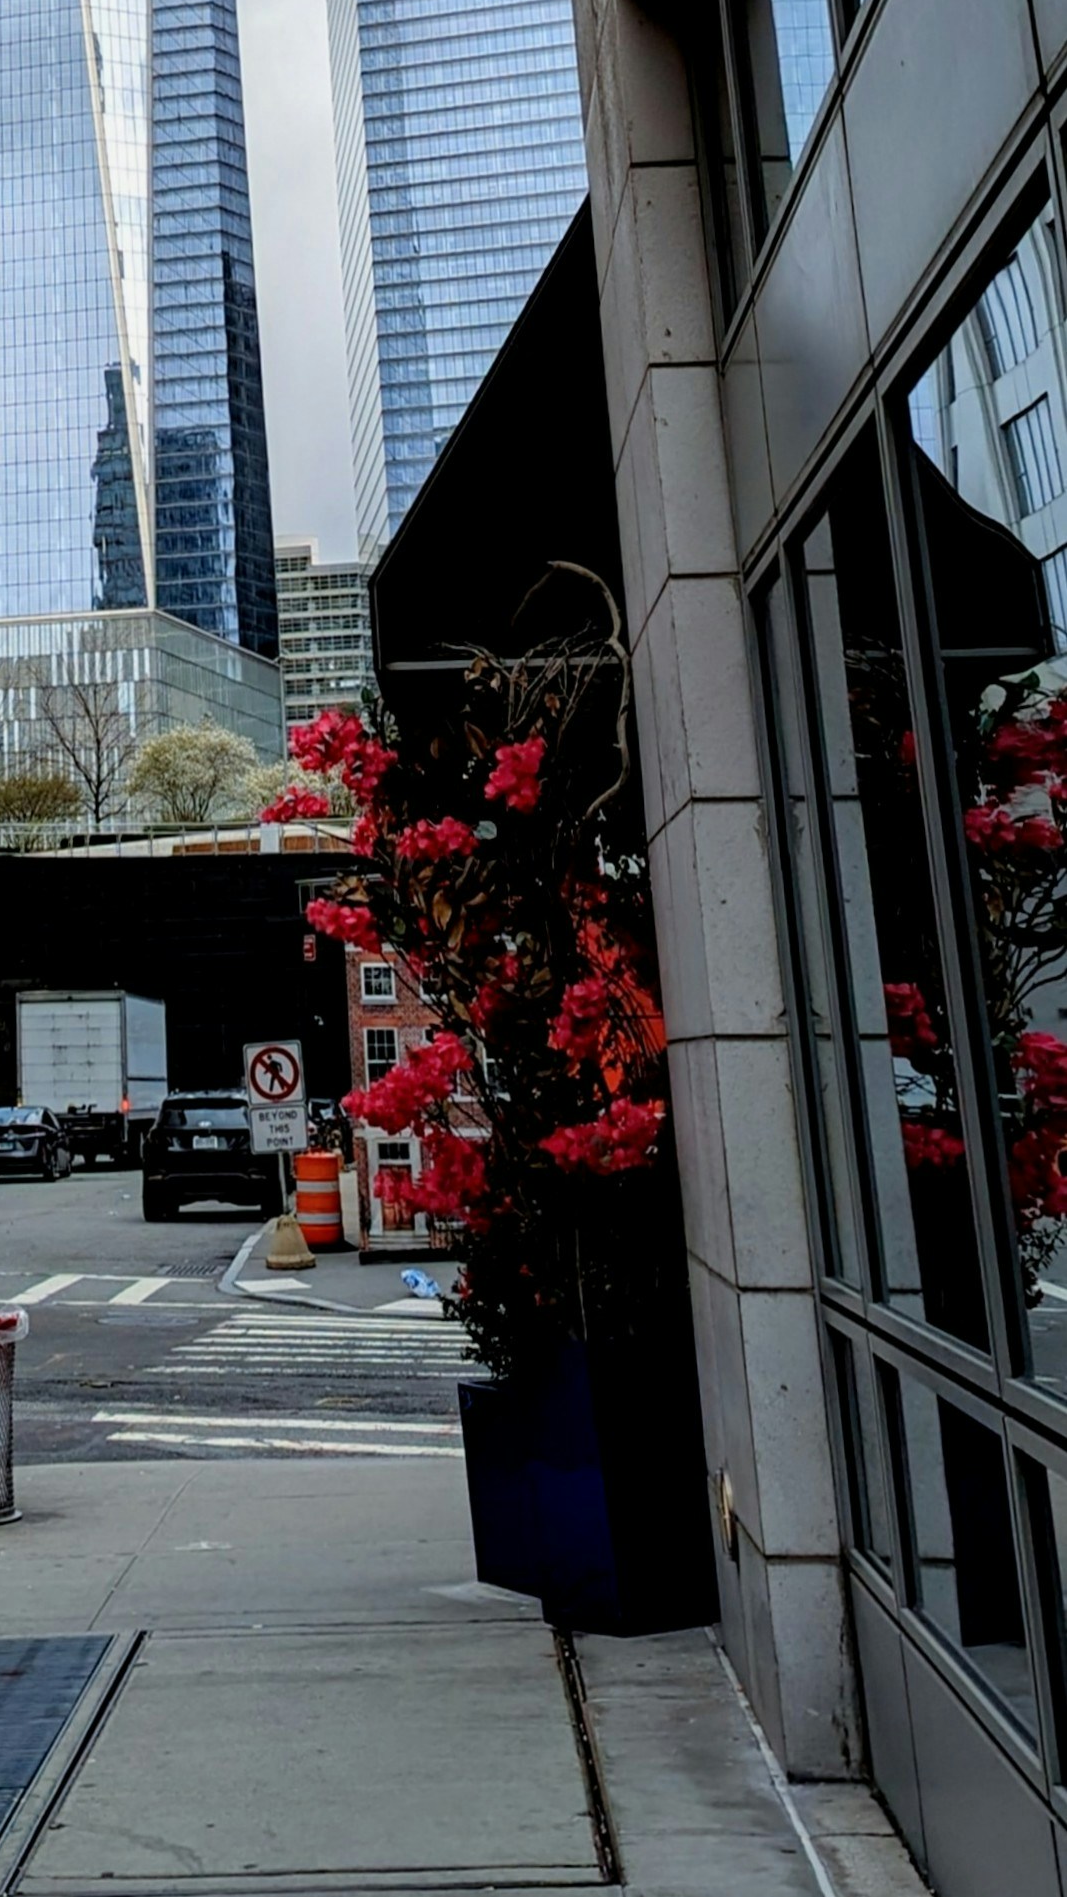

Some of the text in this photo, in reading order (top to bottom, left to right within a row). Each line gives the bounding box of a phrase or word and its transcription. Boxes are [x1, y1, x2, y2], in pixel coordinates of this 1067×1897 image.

[259, 1110, 298, 1122] BEYOND
[269, 1124, 290, 1133] THIS
[267, 1137, 294, 1147] POINT
